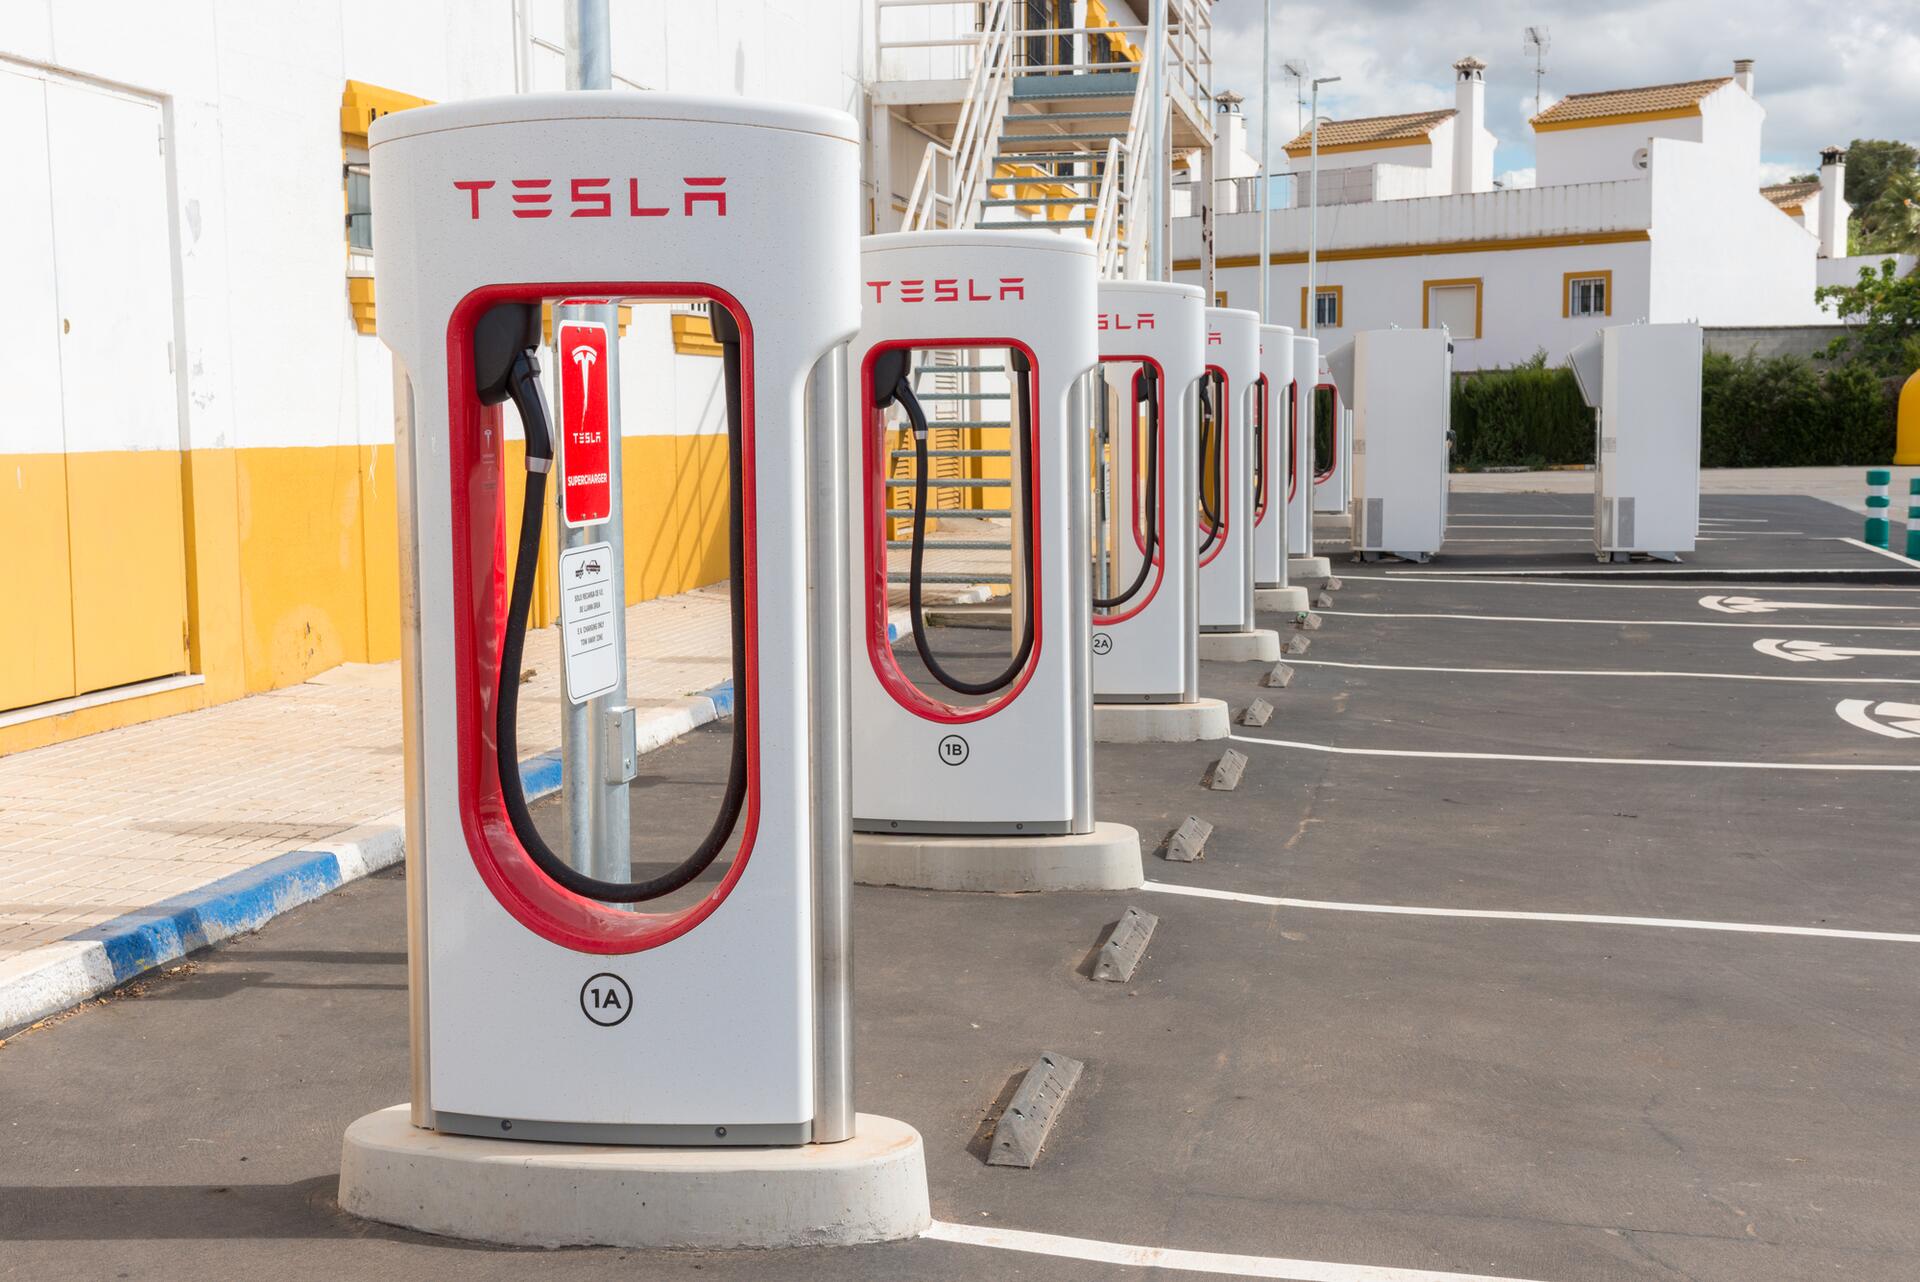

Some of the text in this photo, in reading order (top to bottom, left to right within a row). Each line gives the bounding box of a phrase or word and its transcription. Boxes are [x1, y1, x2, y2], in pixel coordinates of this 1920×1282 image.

[453, 177, 727, 219] TESLA
[865, 278, 1024, 303] TESLA
[572, 431, 601, 444] TESLA
[567, 473, 608, 486] SUPERCHARGER
[1094, 639, 1109, 648] 2A
[945, 744, 962, 755] 1B
[590, 988, 622, 1009] 1A
